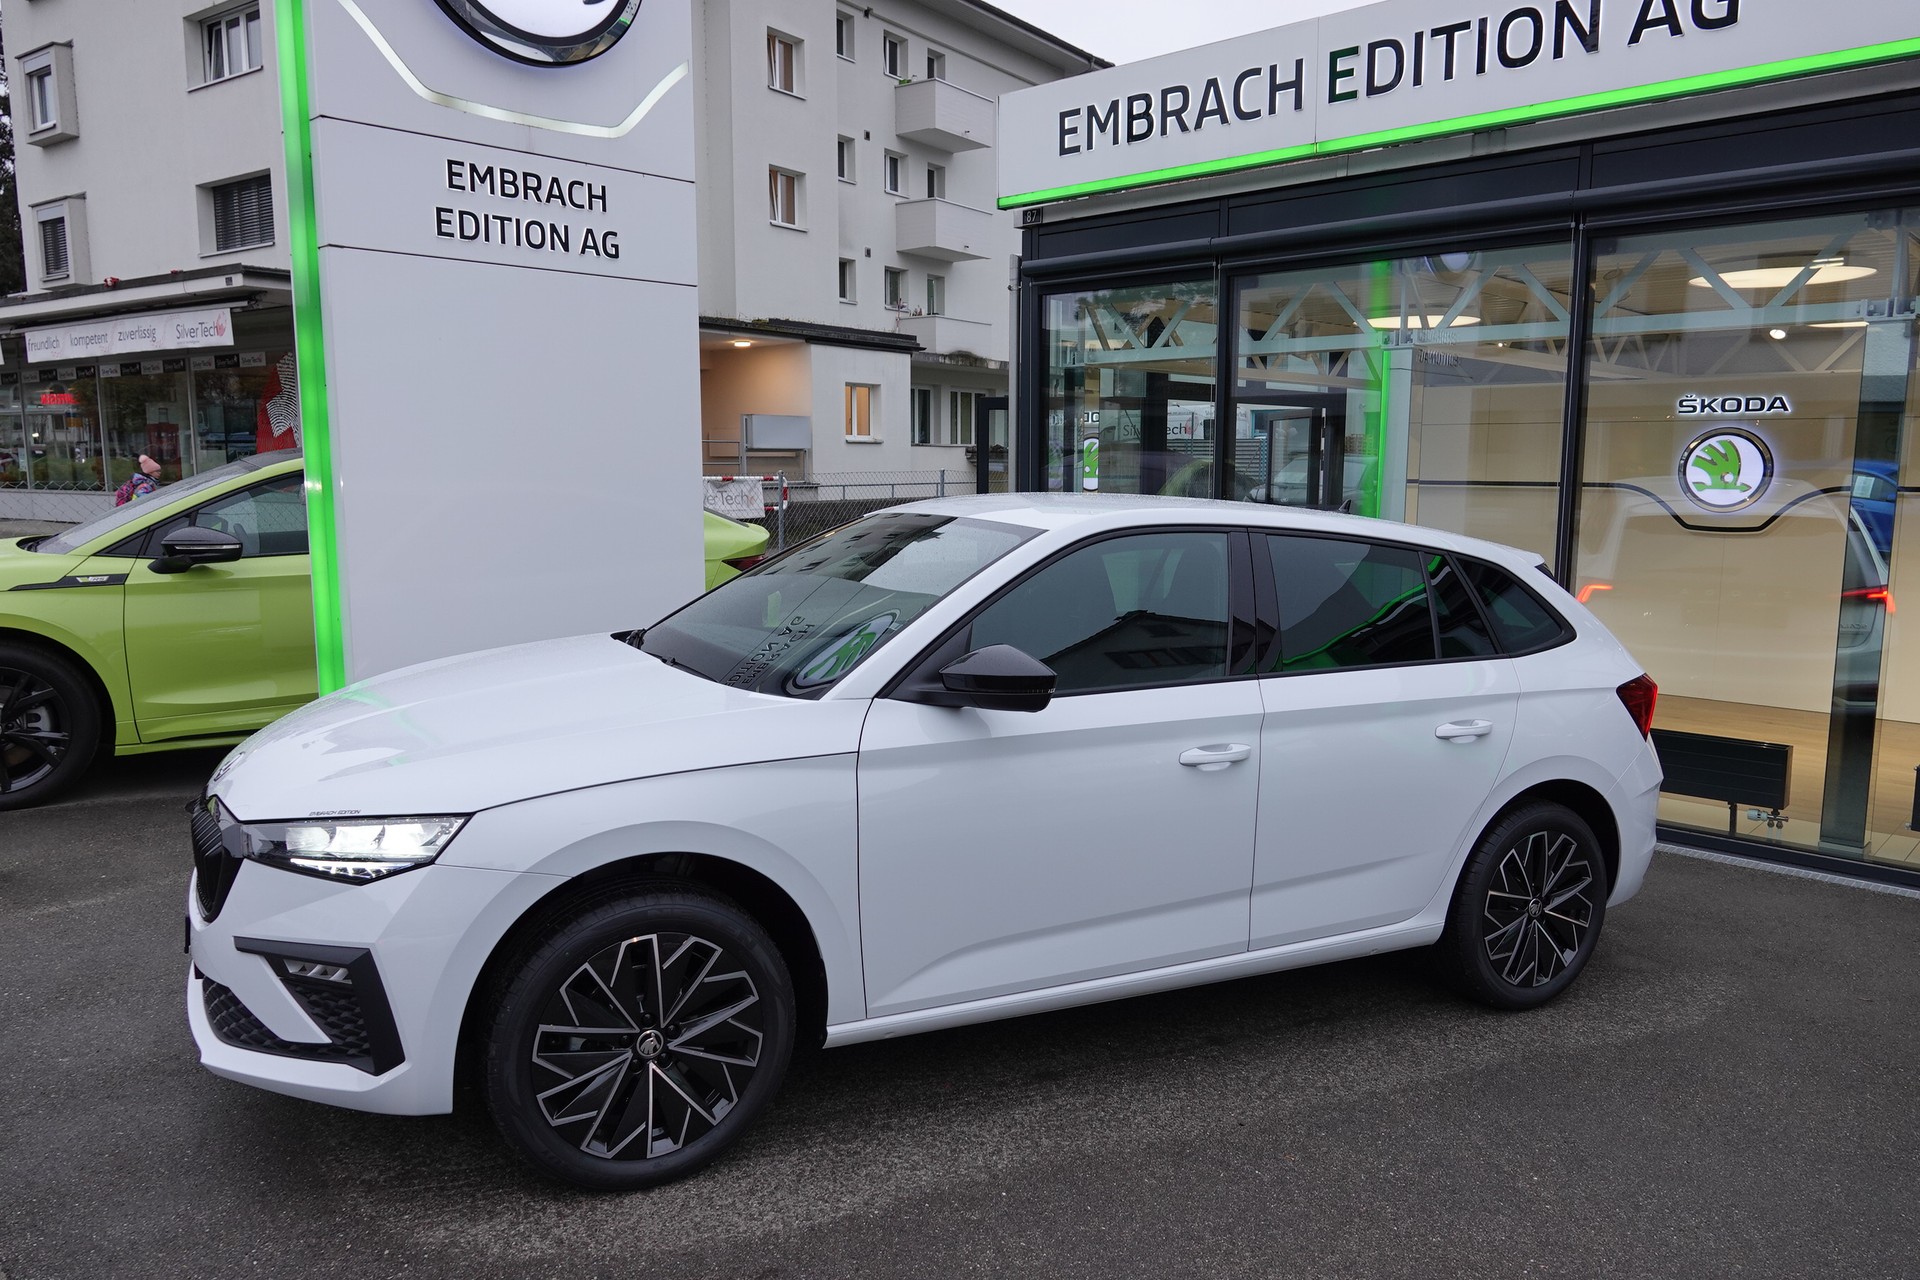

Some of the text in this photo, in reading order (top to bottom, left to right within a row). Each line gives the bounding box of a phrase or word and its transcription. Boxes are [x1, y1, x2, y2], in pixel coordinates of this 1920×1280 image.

[1059, 58, 1304, 157] EMBRACH
[1328, 0, 1600, 104] EDITION
[446, 159, 607, 213] EMBRACH
[434, 206, 620, 259] EDITION AG
[1026, 210, 1037, 222] 87
[28, 336, 60, 352] freundlich
[70, 333, 108, 349] kompetent
[176, 321, 219, 340] SilverTech
[1678, 394, 1790, 413] ŠKODA
